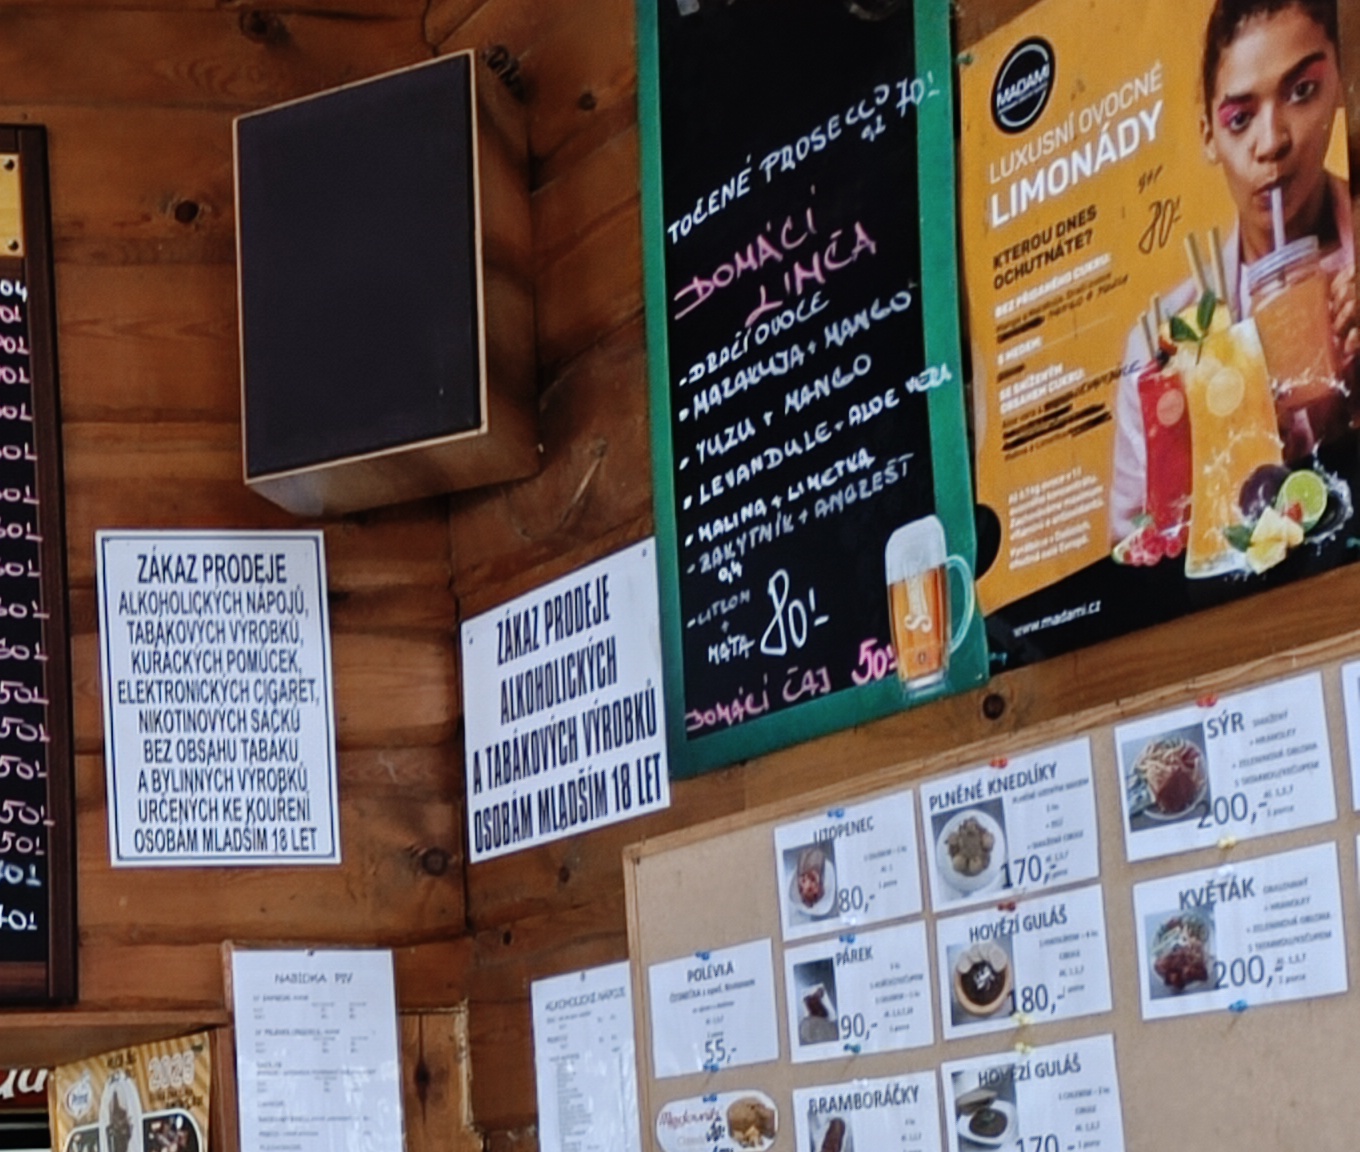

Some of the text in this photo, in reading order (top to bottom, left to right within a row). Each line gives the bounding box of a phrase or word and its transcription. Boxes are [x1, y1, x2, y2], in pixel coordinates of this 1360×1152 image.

[989, 59, 1164, 184] LUXUSNÍ OVOCNÉ
[991, 102, 1164, 228] LIMONÁDY
[993, 205, 1098, 270] KTEROU DNES
[993, 229, 1094, 289] OCHUTNÁTE?
[203, 554, 287, 583] PRODEJE
[496, 574, 610, 666] ZÁKAZ PRODEJE
[500, 636, 617, 725] ALKOHOLICKÝCH
[1206, 710, 1245, 739] SÝR
[144, 738, 237, 764] BEZ OBSAHU
[472, 750, 482, 795] A
[485, 714, 578, 790] TABÁKOVÝCH
[138, 768, 148, 793] A
[988, 762, 1058, 798] KNEDLÍKY
[223, 798, 242, 823] KE
[474, 790, 533, 854] OSOBÁM
[612, 761, 630, 812] 18
[636, 753, 661, 805] LET
[271, 827, 317, 852] 18 LET
[1179, 877, 1256, 911] KVĚTÁK
[1023, 905, 1068, 931] GULÁŠ
[1035, 1053, 1081, 1079] GULÁŠ
